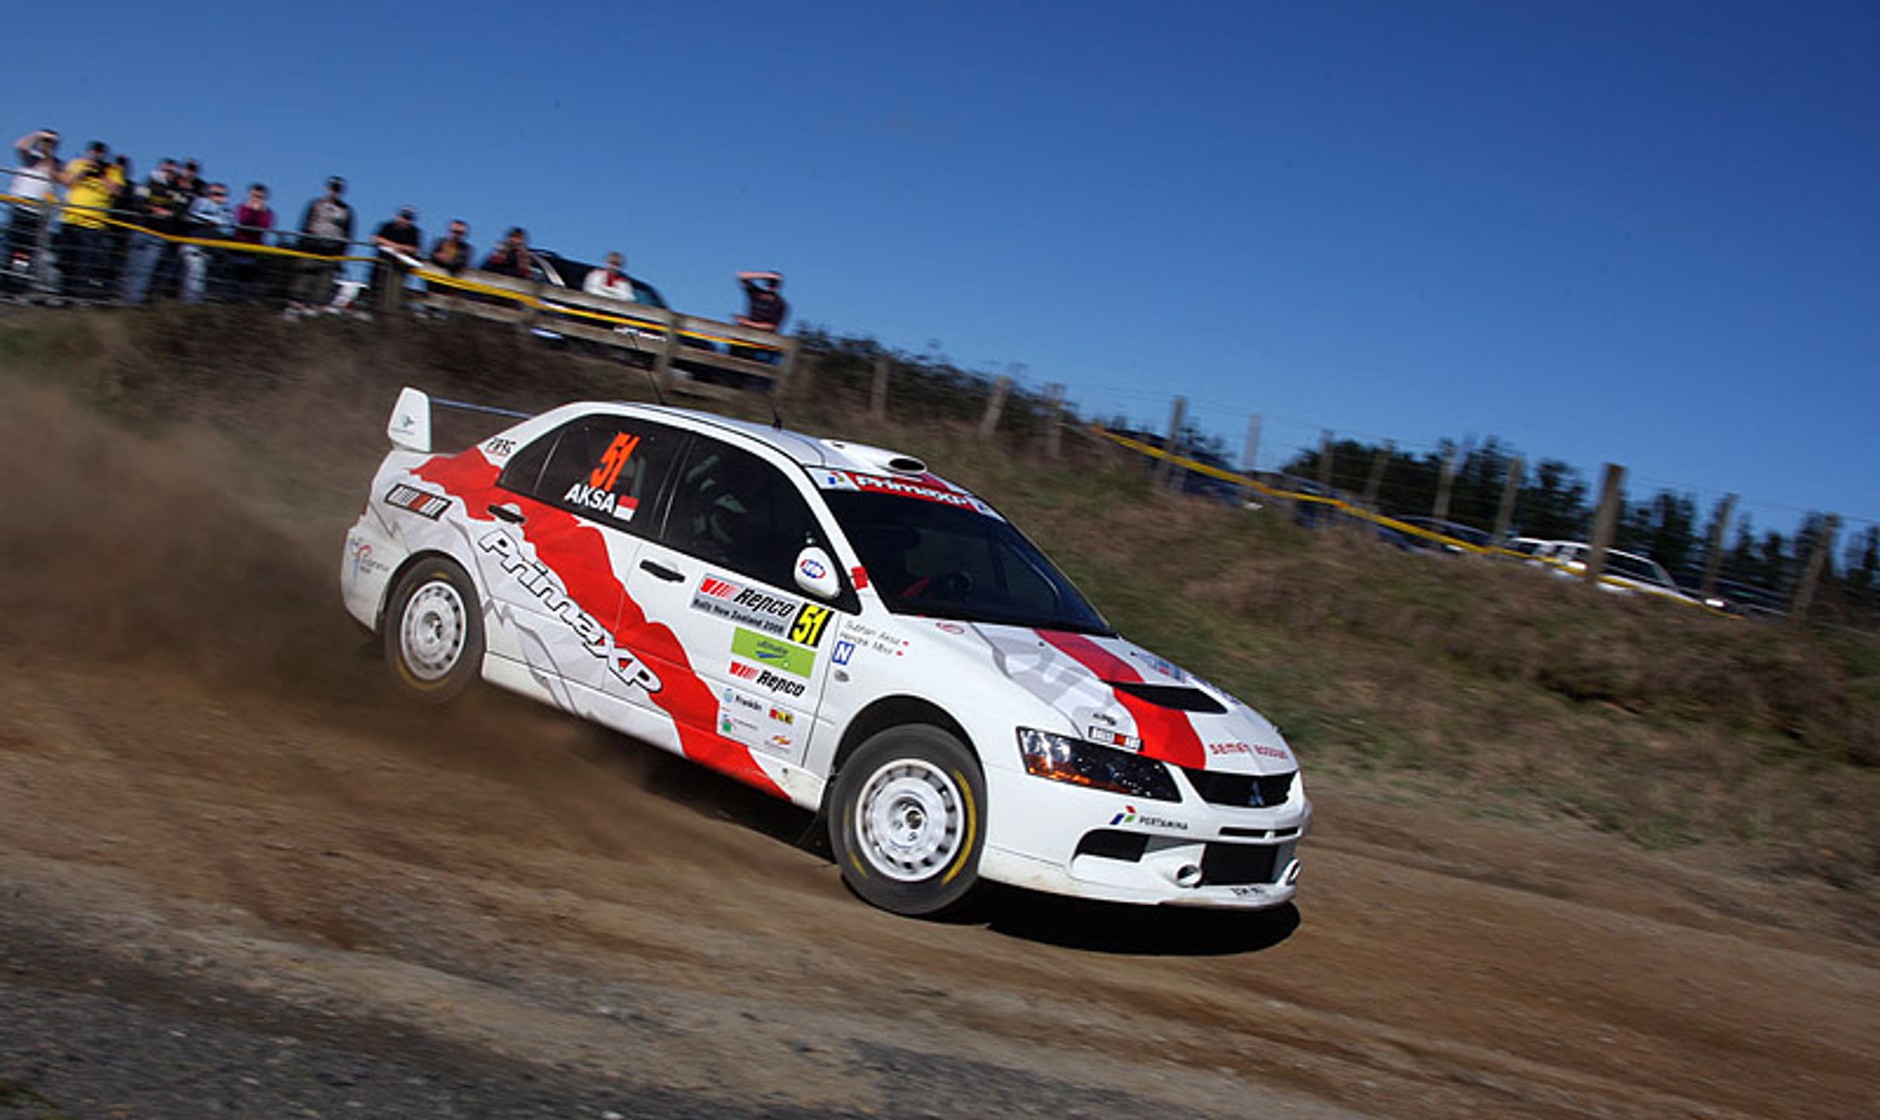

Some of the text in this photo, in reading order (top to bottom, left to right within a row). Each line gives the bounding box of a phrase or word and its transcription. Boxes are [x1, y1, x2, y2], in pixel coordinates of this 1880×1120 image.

[590, 431, 640, 492] 51
[563, 483, 617, 514] AKSA
[733, 587, 797, 617] Repco
[792, 604, 829, 646] 51
[757, 669, 806, 698] Repco
